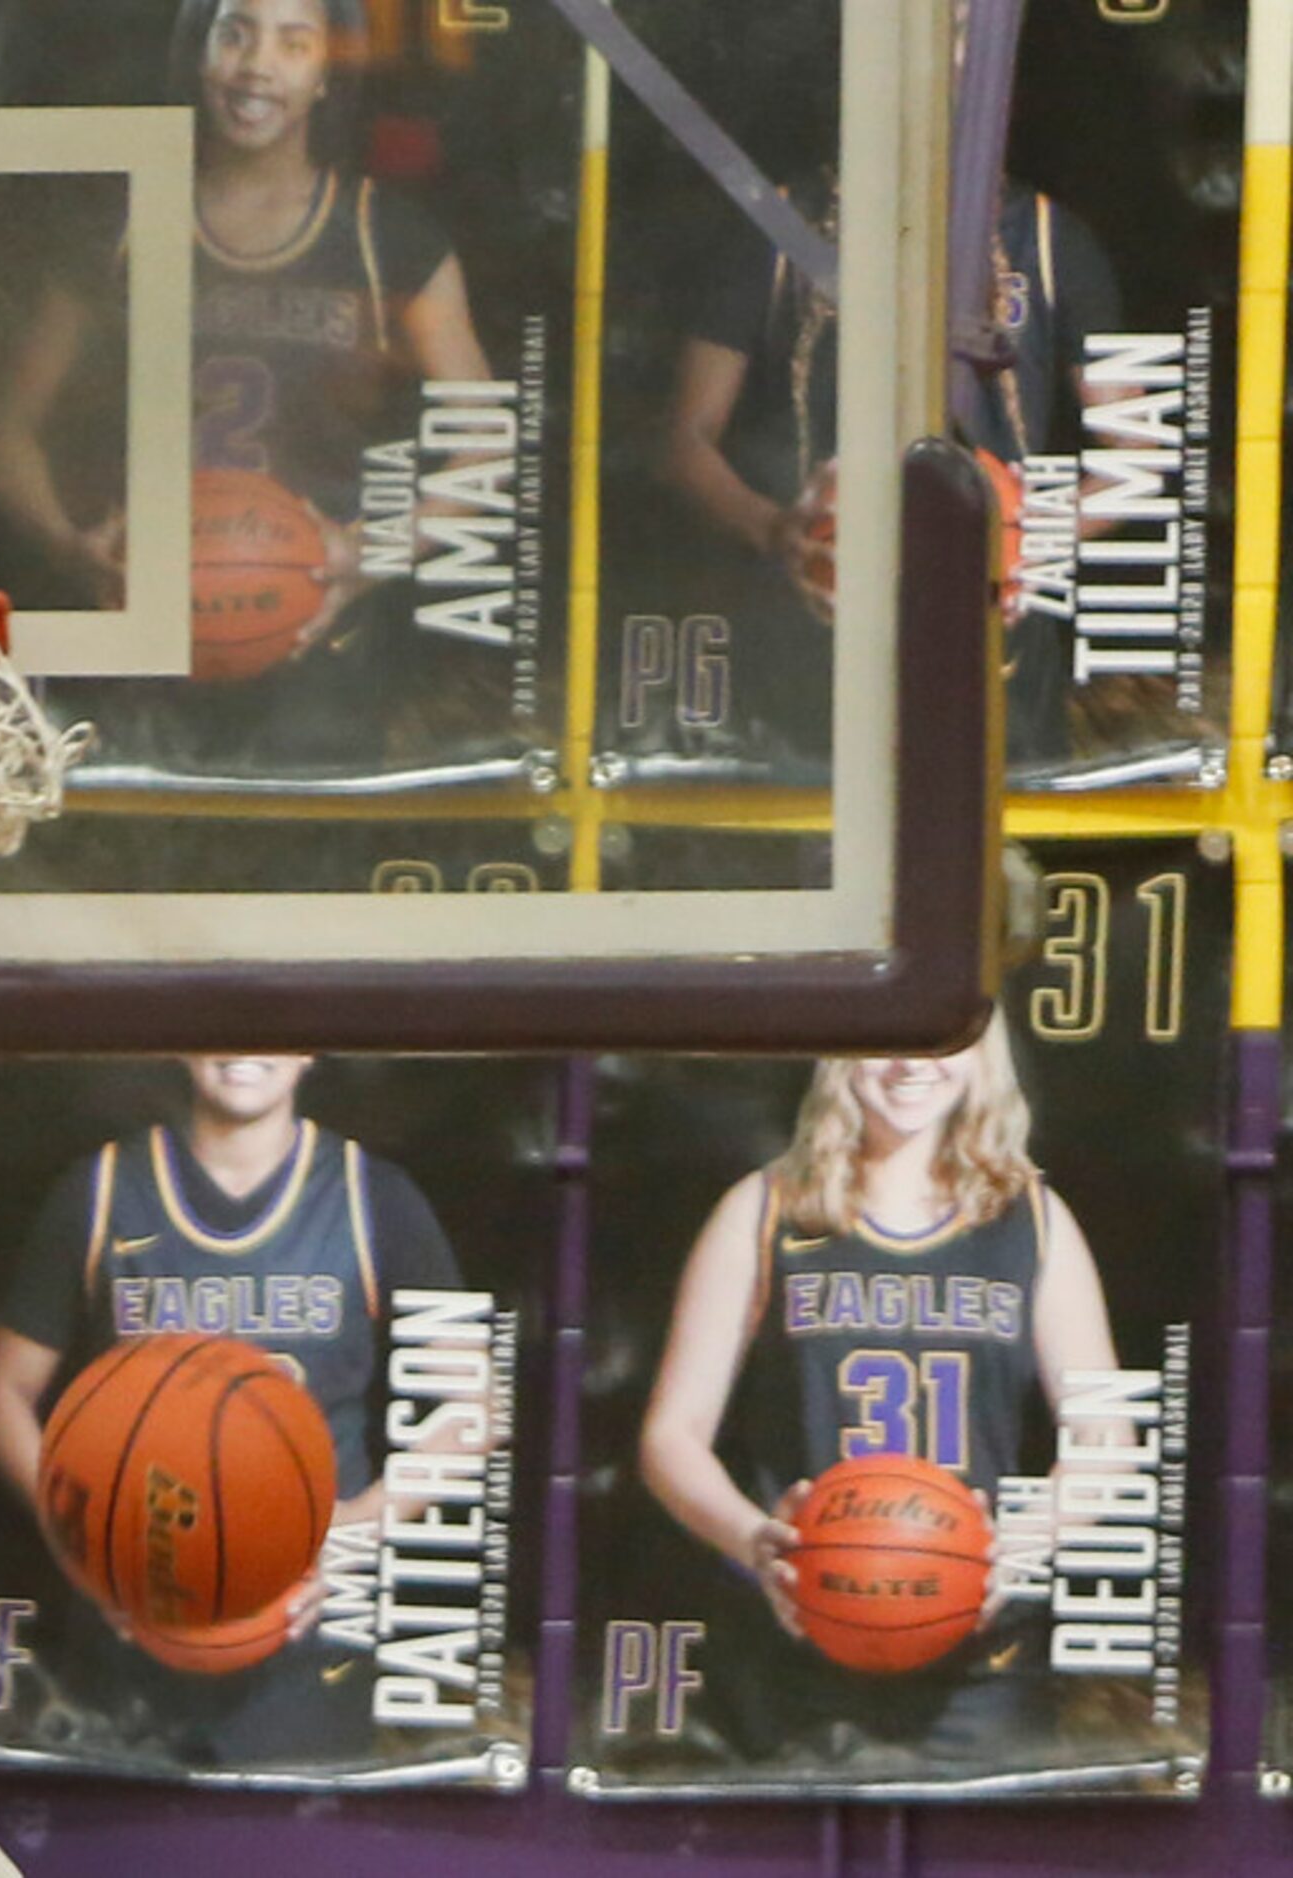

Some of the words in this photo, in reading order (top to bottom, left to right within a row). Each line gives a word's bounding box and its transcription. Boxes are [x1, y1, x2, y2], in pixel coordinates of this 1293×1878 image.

[359, 439, 416, 576] NADIA
[414, 380, 520, 644] AMADI
[1017, 454, 1078, 619] ZARIAH
[1073, 334, 1185, 683] TILLMAN
[619, 614, 730, 728] PG
[112, 1275, 344, 1335] EAGLES
[785, 1271, 1023, 1339] EAGLES
[838, 1348, 972, 1472] 31
[373, 1288, 493, 1726] PATTERSON
[997, 1475, 1053, 1600] FAITH
[1050, 1369, 1162, 1672] REUBEN
[319, 1520, 379, 1648] AMYA
[602, 1620, 706, 1736] PF
